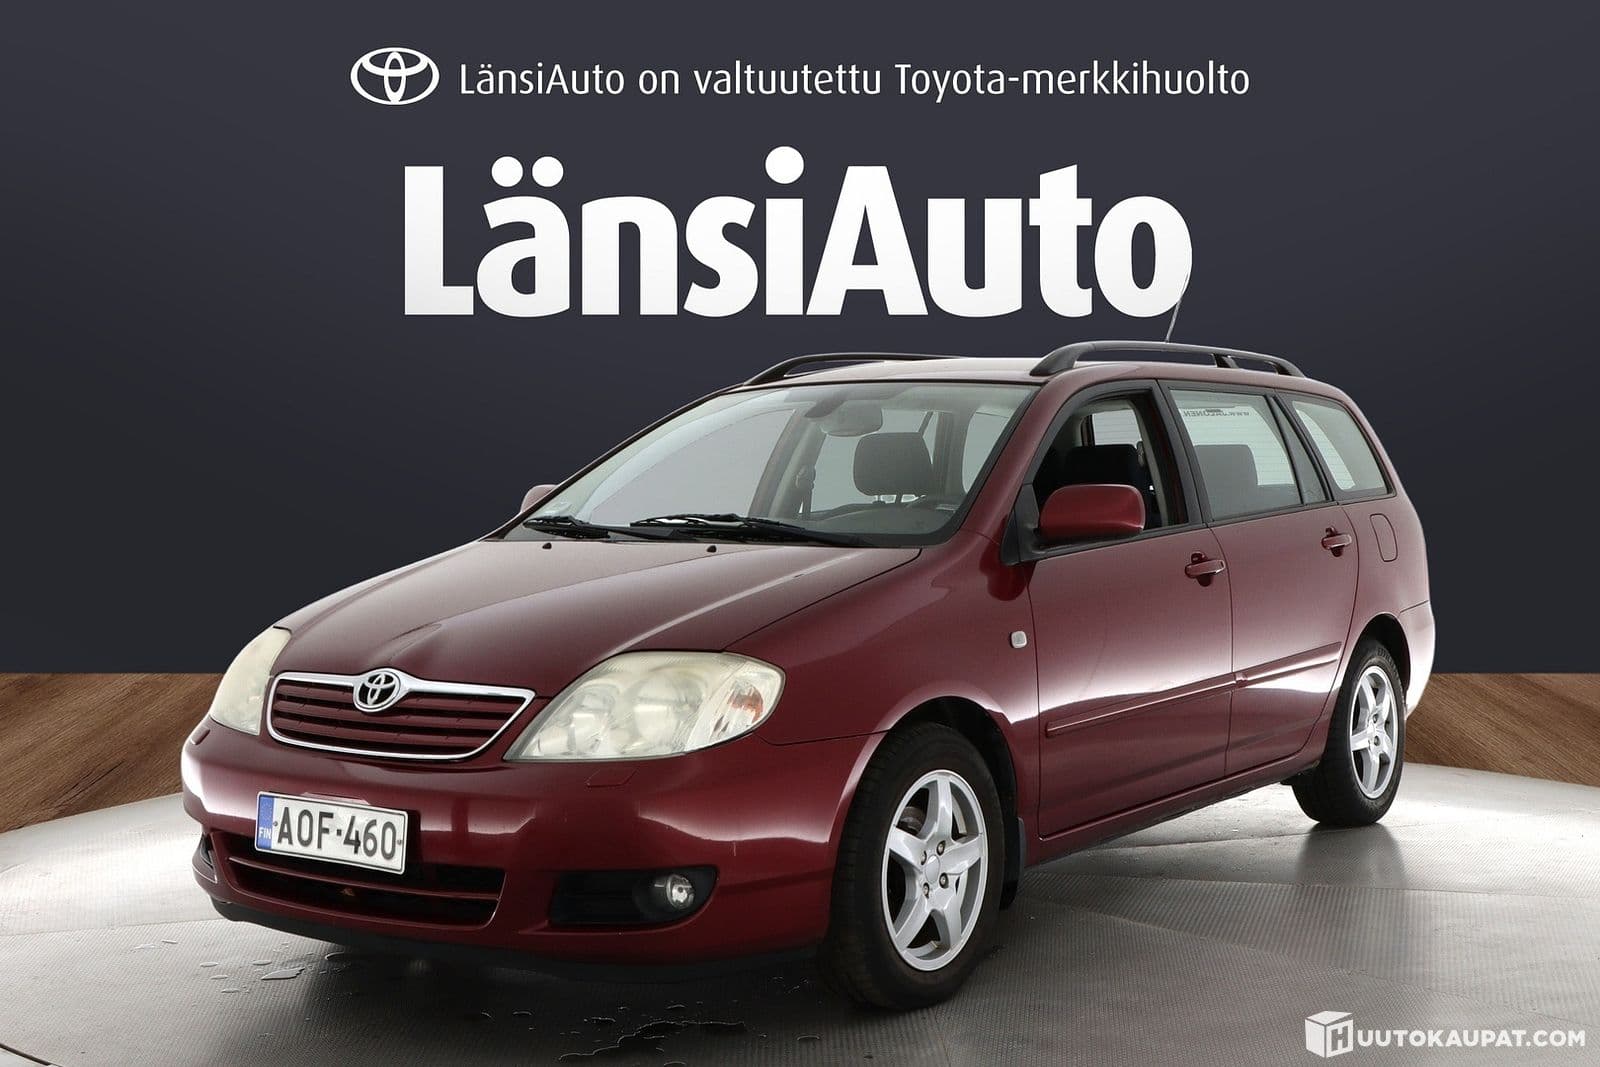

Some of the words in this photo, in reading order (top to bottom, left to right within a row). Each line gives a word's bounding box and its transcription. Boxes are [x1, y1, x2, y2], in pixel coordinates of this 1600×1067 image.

[460, 62, 625, 95] LänsiAuto
[638, 69, 680, 95] on
[693, 63, 881, 95] valtuutettu
[894, 59, 1250, 104] Toyota-merkkihuolto
[404, 146, 1193, 318] LänsiAuto
[258, 827, 271, 841] FIN
[277, 806, 396, 859] AOF-460
